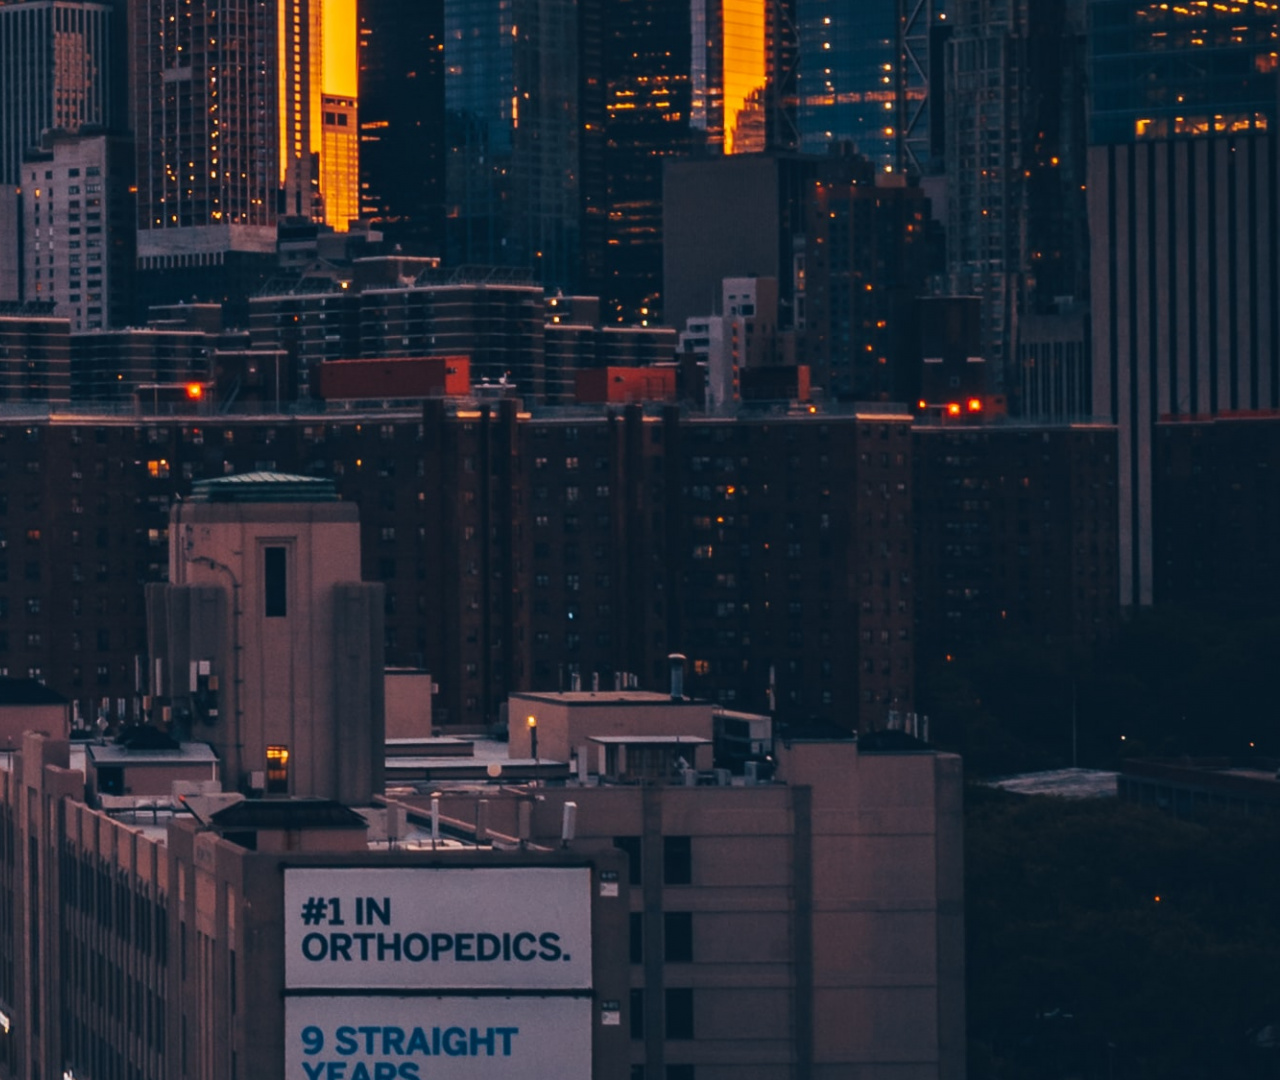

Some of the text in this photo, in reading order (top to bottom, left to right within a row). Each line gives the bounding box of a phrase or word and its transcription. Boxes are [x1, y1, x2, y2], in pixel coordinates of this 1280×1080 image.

[301, 897, 390, 925] #1 IN
[301, 932, 571, 962] ORTHOPEDICS.
[301, 1026, 519, 1057] 9 STRAIGHT
